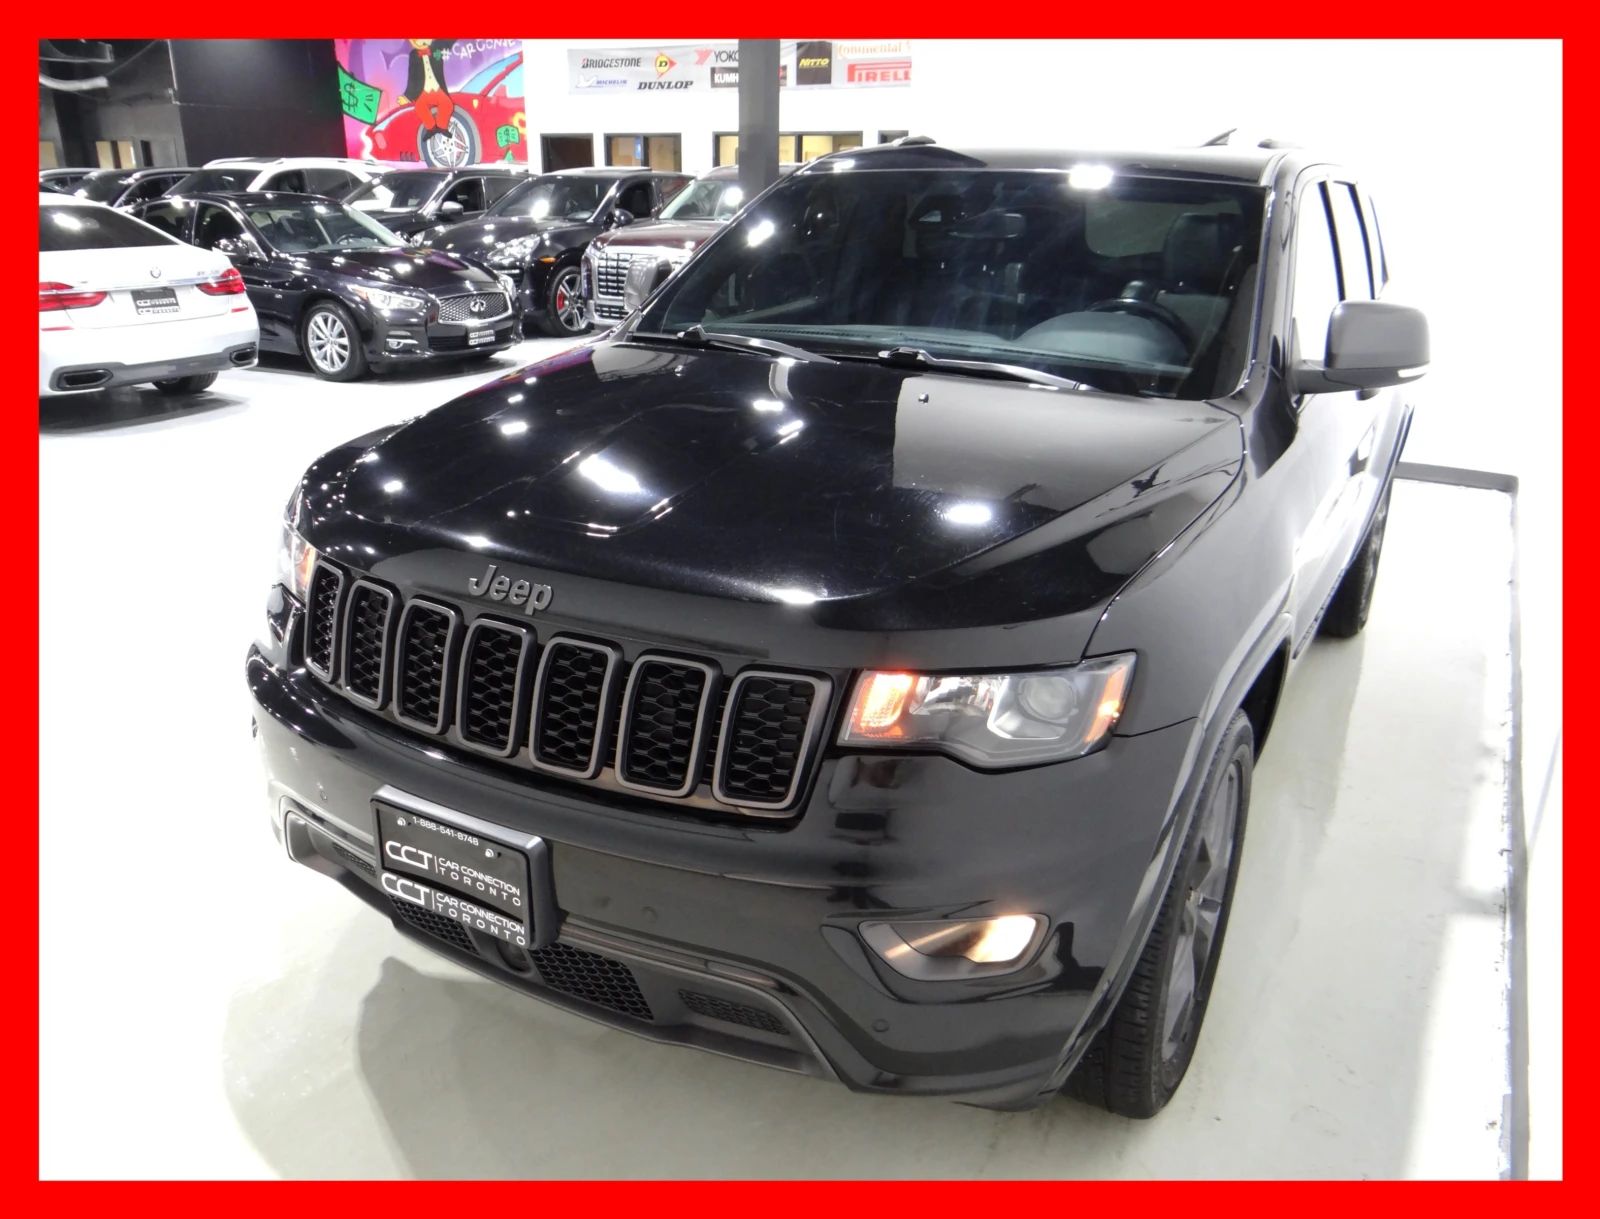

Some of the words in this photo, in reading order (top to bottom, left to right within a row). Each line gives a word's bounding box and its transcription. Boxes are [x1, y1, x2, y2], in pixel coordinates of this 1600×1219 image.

[581, 57, 642, 69] BRIDGESTONE
[799, 58, 830, 68] NITTO
[637, 80, 693, 90] DUNLOP
[468, 564, 554, 616] Jeep
[412, 816, 480, 846] 1-888-541-8748
[385, 840, 433, 870] CCT
[381, 873, 430, 906] CCT
[438, 857, 460, 871] CAR
[460, 865, 521, 896] CONNECTION
[440, 867, 521, 907] TORONTO
[436, 893, 459, 908] CAR
[459, 901, 525, 935] CONNECTION
[436, 903, 526, 946] TORONTO
